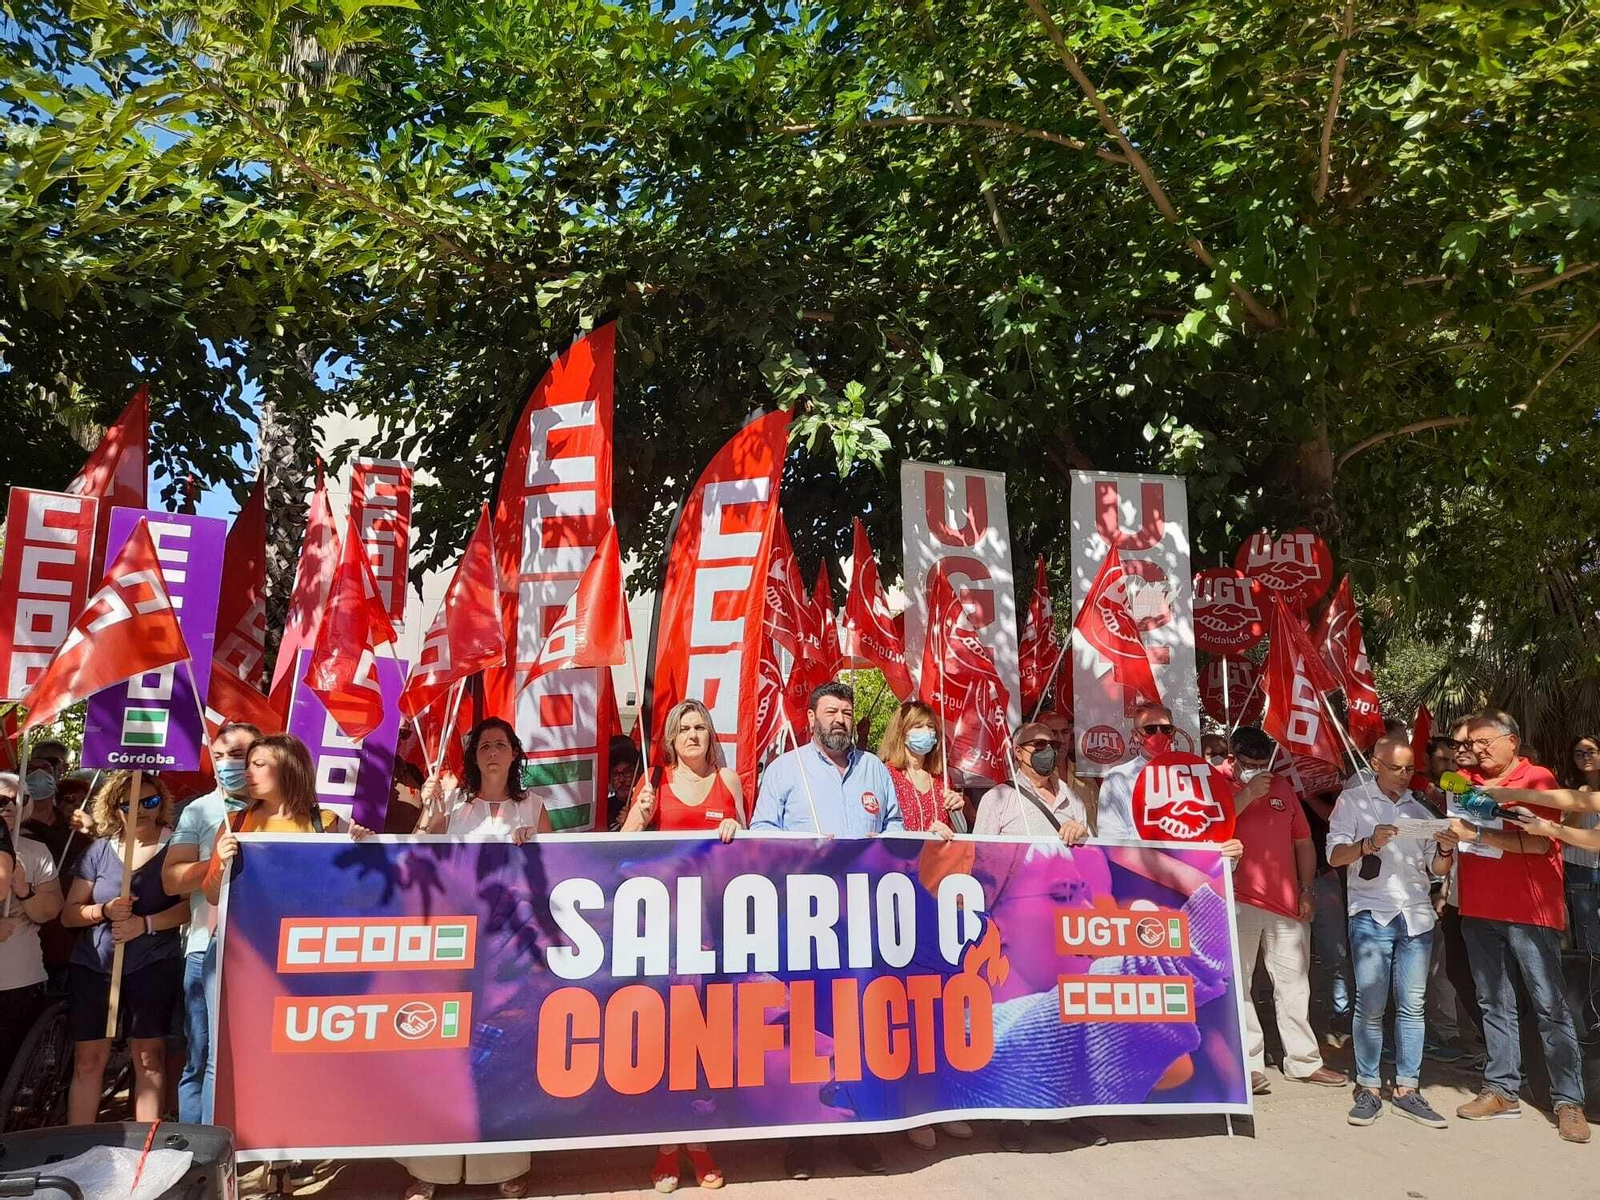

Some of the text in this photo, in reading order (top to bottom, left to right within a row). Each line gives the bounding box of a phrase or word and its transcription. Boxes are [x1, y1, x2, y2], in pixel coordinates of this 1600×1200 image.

[1248, 534, 1315, 566] UGT
[1193, 578, 1254, 609] UGT
[684, 477, 769, 768] CCO
[1200, 631, 1251, 645] Andalucía
[1208, 662, 1252, 687] UGT
[1087, 732, 1119, 748] UGT
[108, 750, 175, 765] Córdoba
[1145, 764, 1215, 808] UGT
[546, 871, 916, 980] SALARIO
[1062, 914, 1130, 947] UGT
[286, 925, 433, 964] CCOO
[1064, 982, 1161, 1015] CCOO
[285, 1005, 388, 1041] UGT
[536, 974, 995, 1098] CONFLICTO
